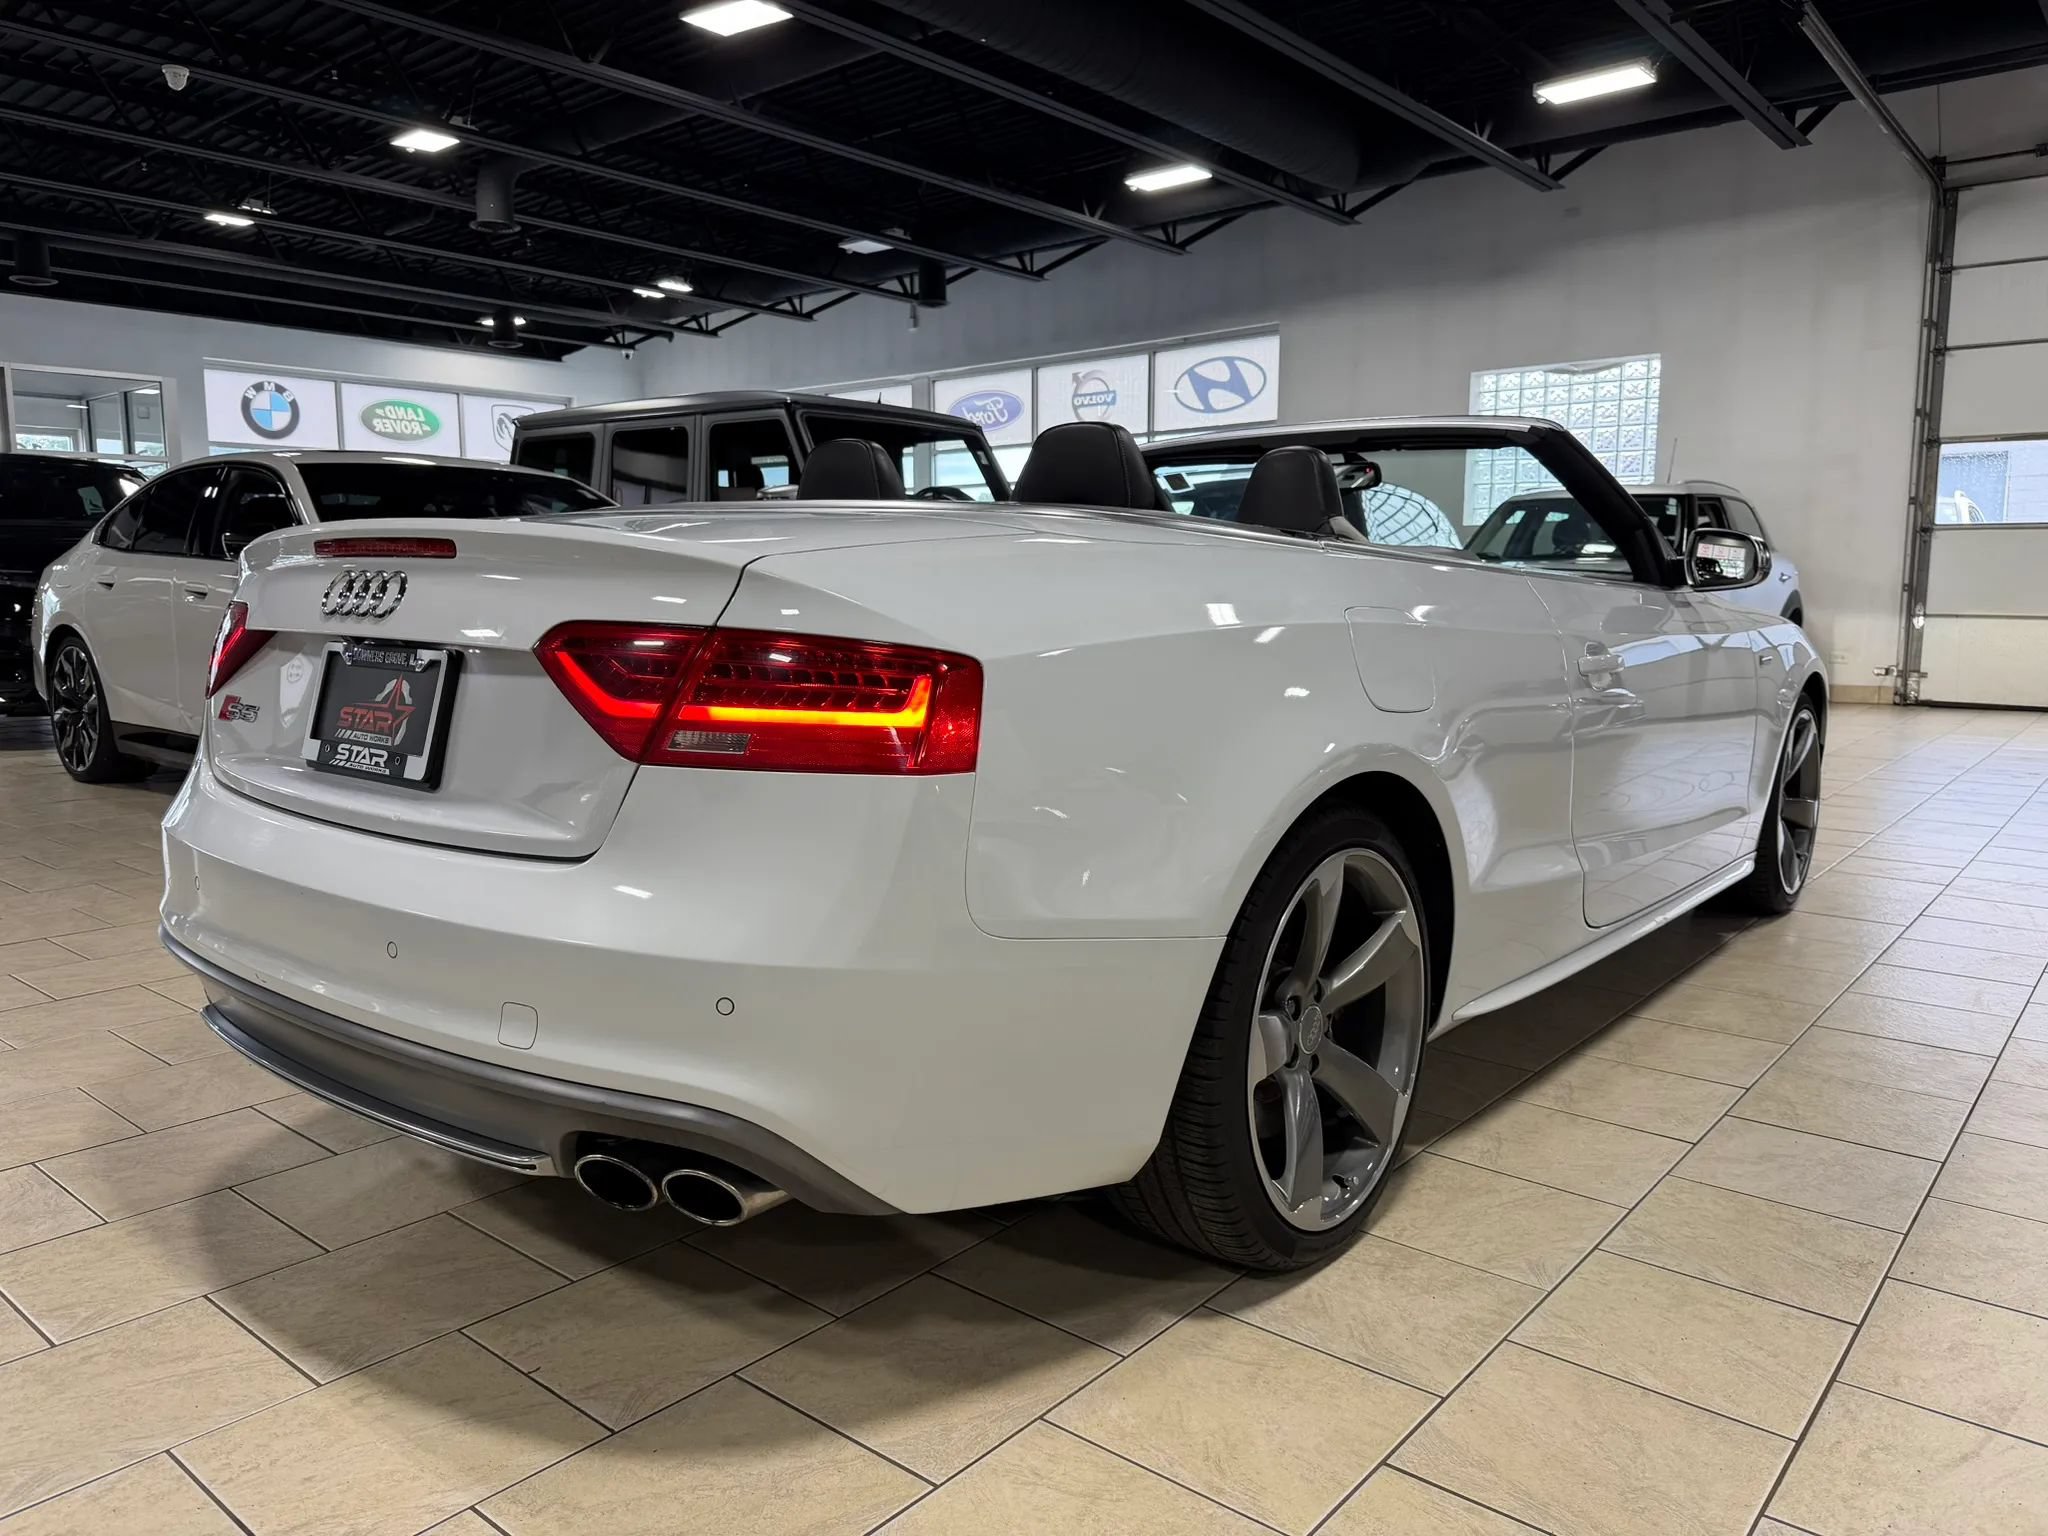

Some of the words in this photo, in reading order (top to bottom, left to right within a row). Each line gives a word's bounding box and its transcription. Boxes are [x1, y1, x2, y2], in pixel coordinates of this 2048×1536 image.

[337, 707, 394, 735] STAR
[353, 733, 368, 741] AUTO
[369, 736, 390, 744] WORKS
[334, 743, 389, 768] STAR
